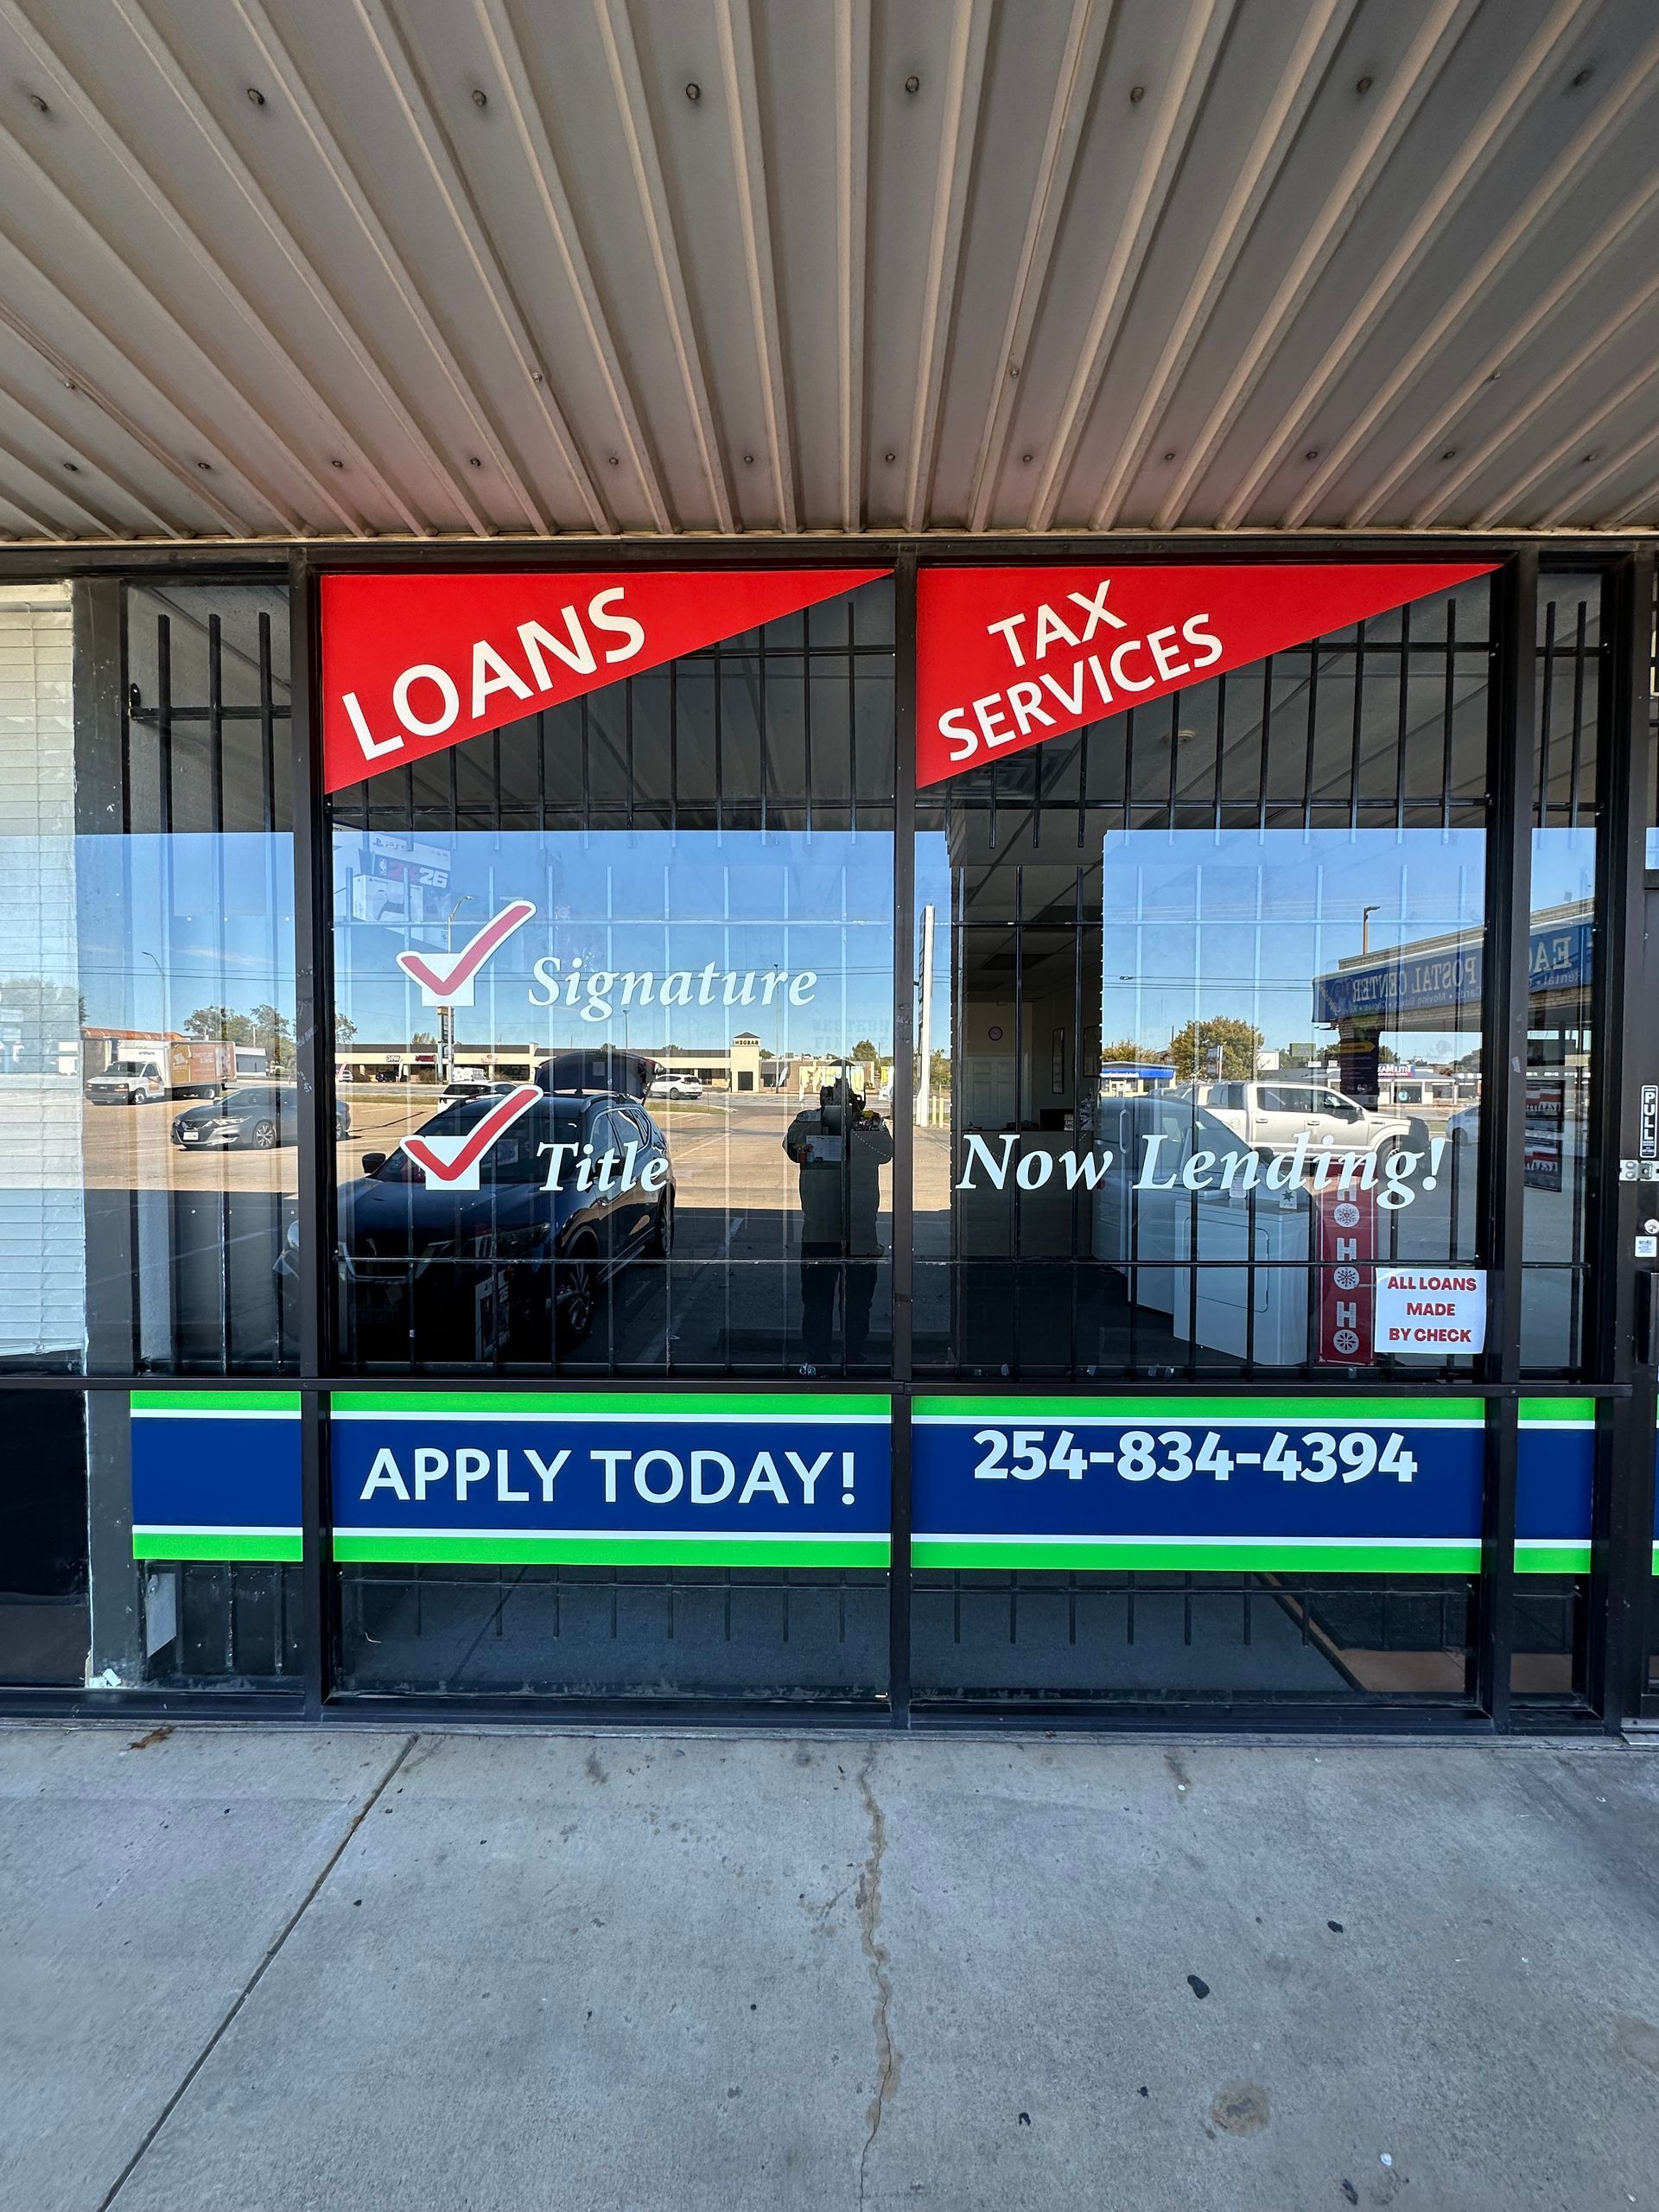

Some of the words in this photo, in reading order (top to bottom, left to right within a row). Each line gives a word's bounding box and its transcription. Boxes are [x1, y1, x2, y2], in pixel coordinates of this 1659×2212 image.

[988, 580, 1127, 668] TAX
[342, 588, 645, 761] LOANS
[938, 614, 1223, 761] SERVICES
[528, 957, 817, 1022] Signature
[1643, 1091, 1656, 1141] PULL
[537, 1140, 669, 1192] Title
[956, 1134, 1114, 1191] Now
[1132, 1132, 1446, 1211] Lending!
[1388, 1276, 1417, 1291] ALL
[1419, 1276, 1477, 1292] LOANS
[1407, 1302, 1456, 1317] MADE
[1389, 1327, 1412, 1341] BY
[1414, 1328, 1471, 1343] CHECK
[360, 1447, 572, 1502] APPLY
[591, 1450, 855, 1505] TODAY!
[974, 1429, 1418, 1484] 254-834-4394
